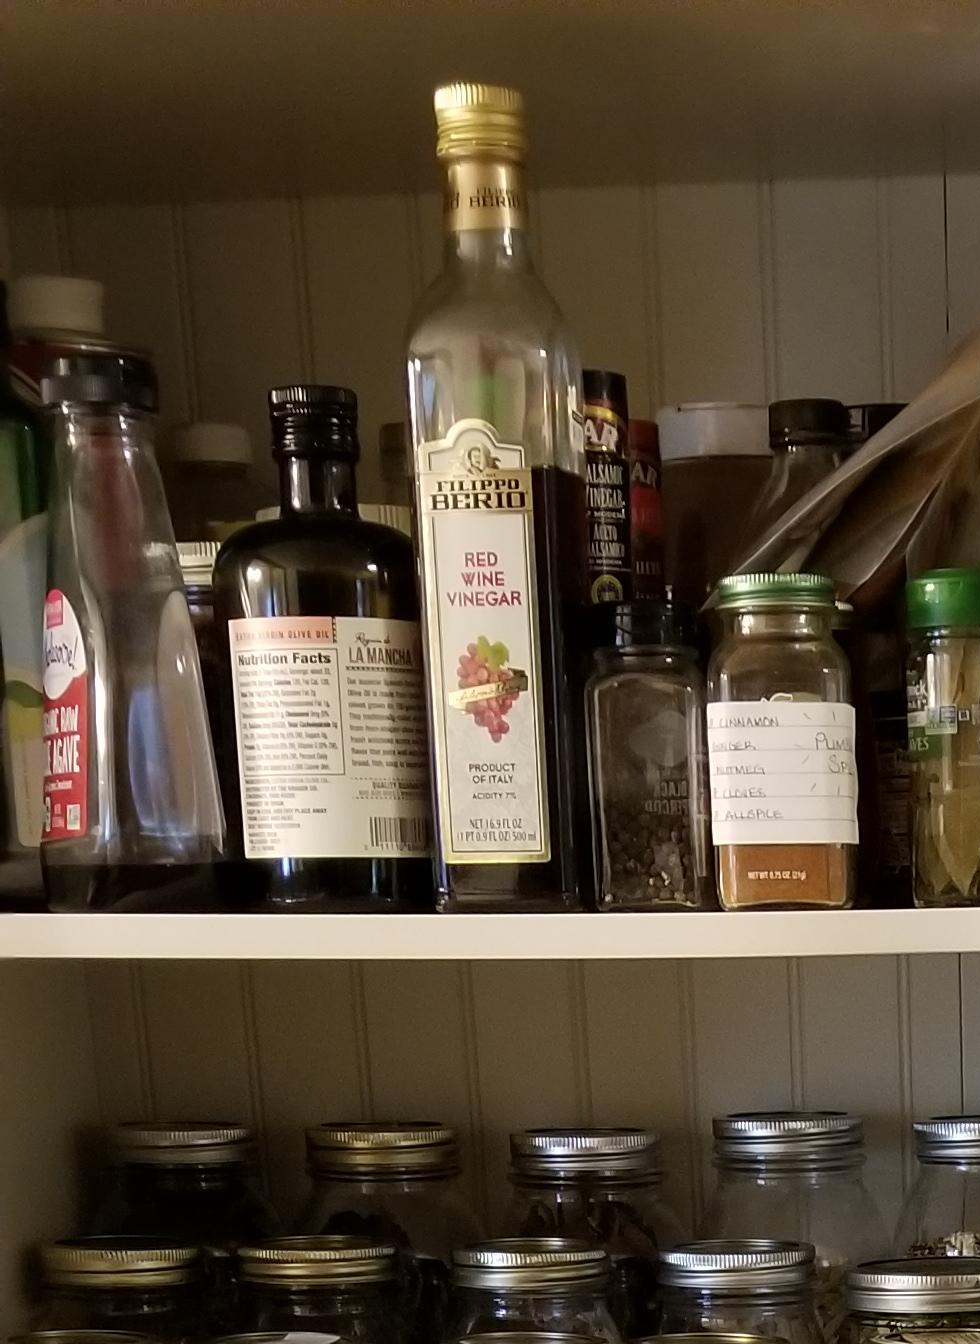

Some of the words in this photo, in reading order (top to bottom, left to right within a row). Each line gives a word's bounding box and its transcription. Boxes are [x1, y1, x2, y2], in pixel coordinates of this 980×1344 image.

[436, 479, 520, 492] FILIPPO
[430, 491, 526, 510] BERIO
[464, 552, 498, 568] RED
[461, 571, 505, 587] WINE
[447, 591, 522, 607] VINEGAR
[288, 630, 313, 640] OLIVE
[238, 653, 288, 667] Nutrition
[292, 652, 331, 664] Facts
[349, 647, 364, 663] LA
[366, 648, 412, 665] MANCHA
[468, 763, 516, 773] PRODUCT
[472, 775, 486, 784] OF
[488, 774, 514, 784] ITALY
[472, 792, 502, 800] ACIDITY
[469, 819, 484, 829] NET
